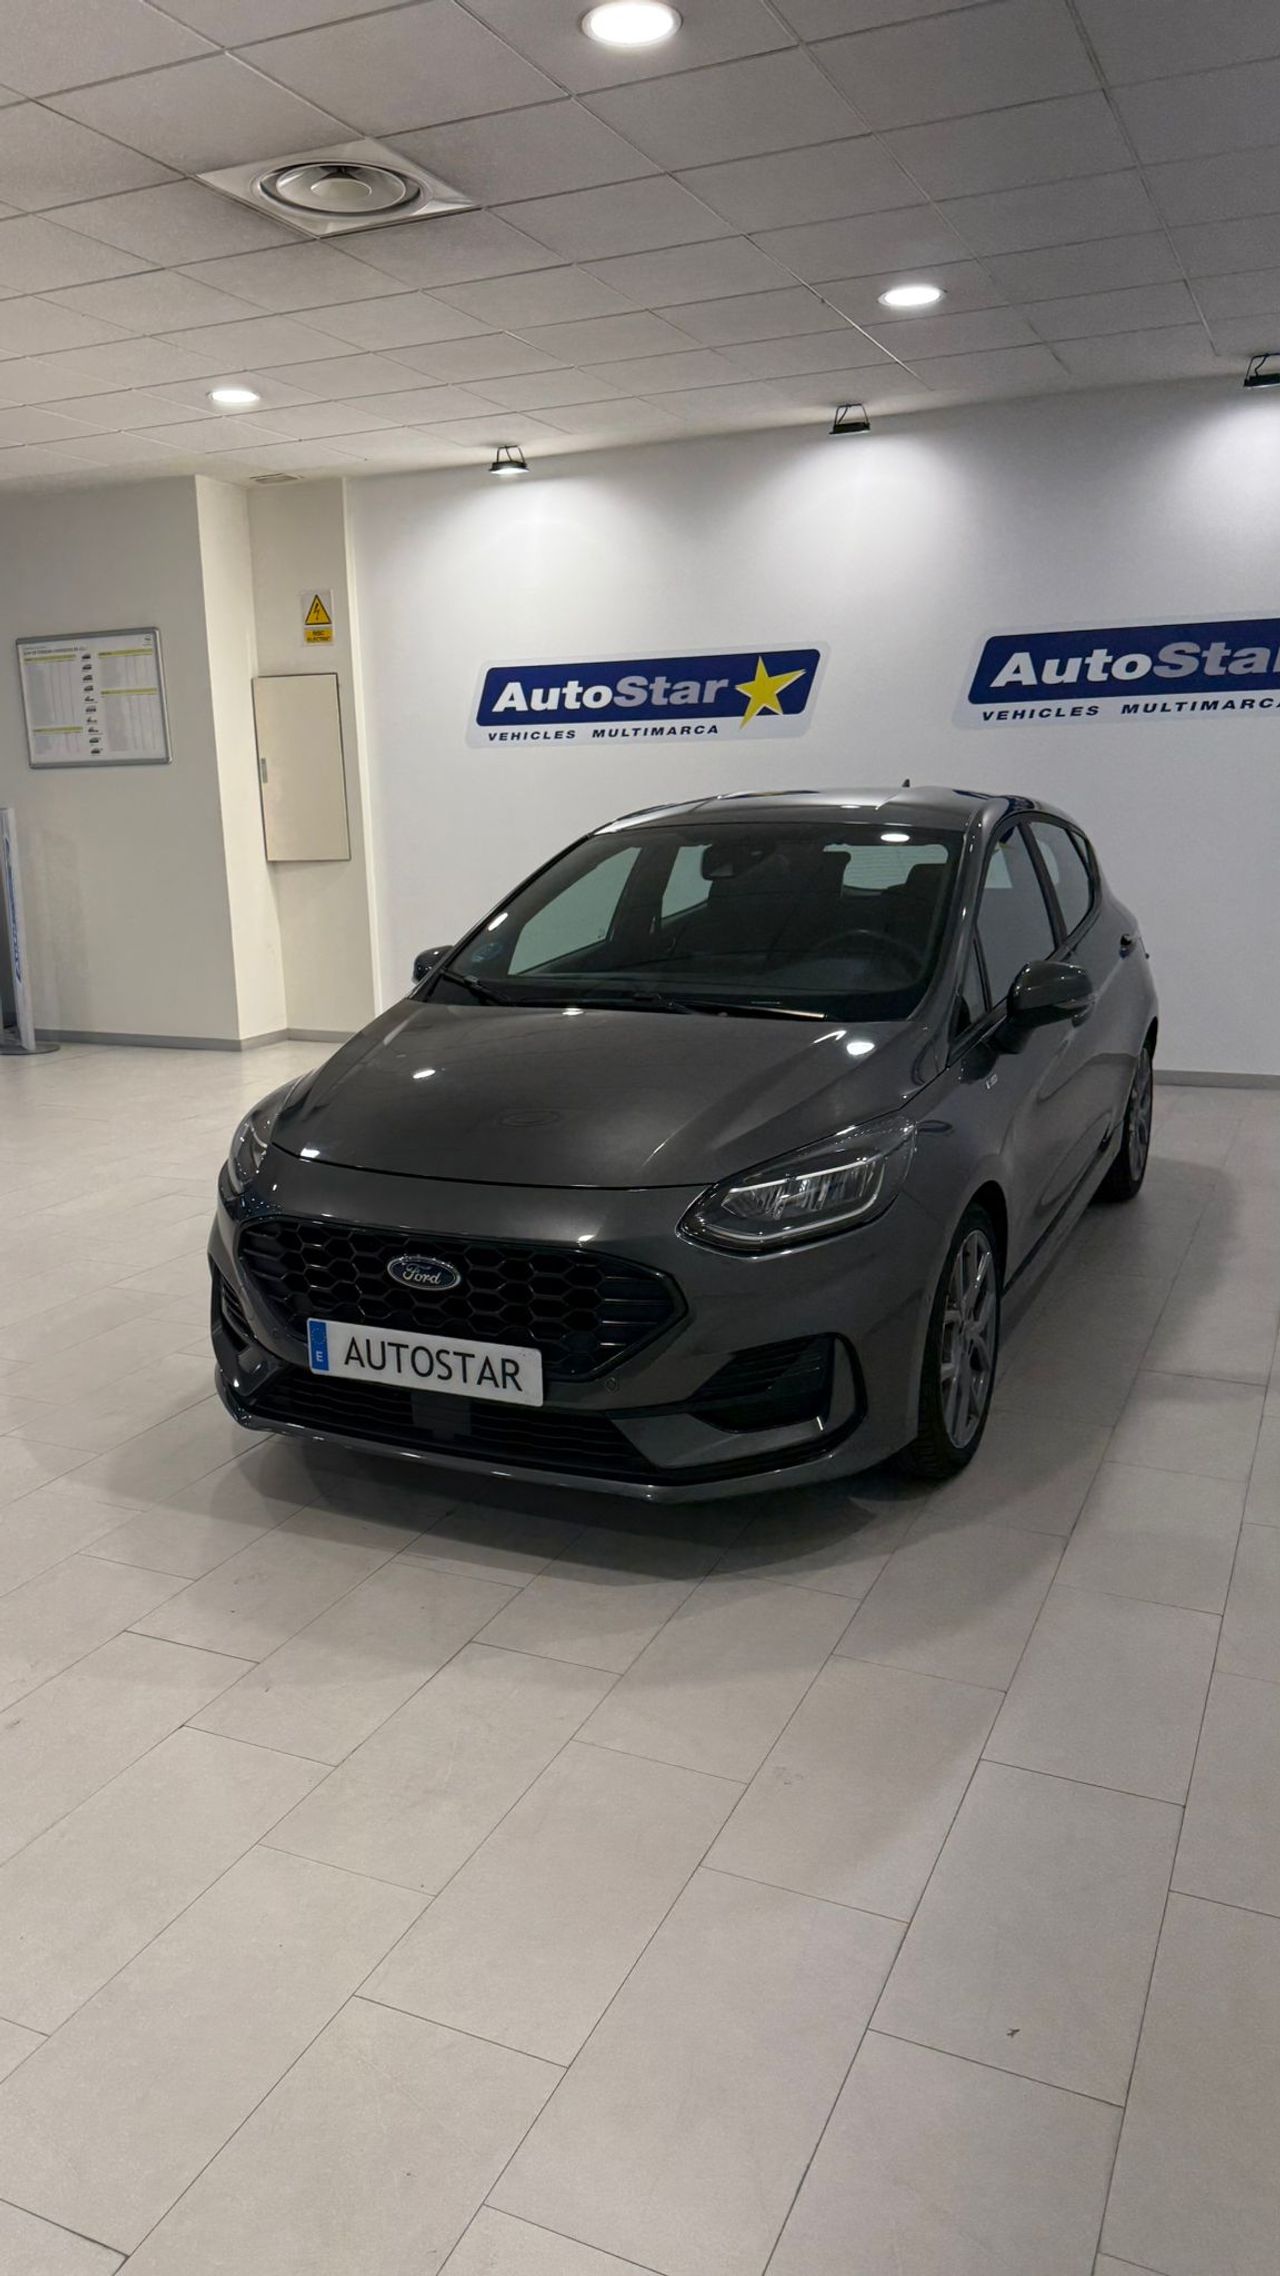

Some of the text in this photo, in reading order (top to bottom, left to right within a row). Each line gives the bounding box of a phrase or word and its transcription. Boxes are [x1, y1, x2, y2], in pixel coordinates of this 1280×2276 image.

[491, 674, 729, 713] AutoStar
[982, 696, 1280, 721] VEHICLES MULTIMARC
[488, 724, 719, 742] VEHICLES MULTIMARCA
[402, 1264, 442, 1285] Ford
[316, 1350, 324, 1362] E
[344, 1336, 523, 1392] AUTOSTAR
